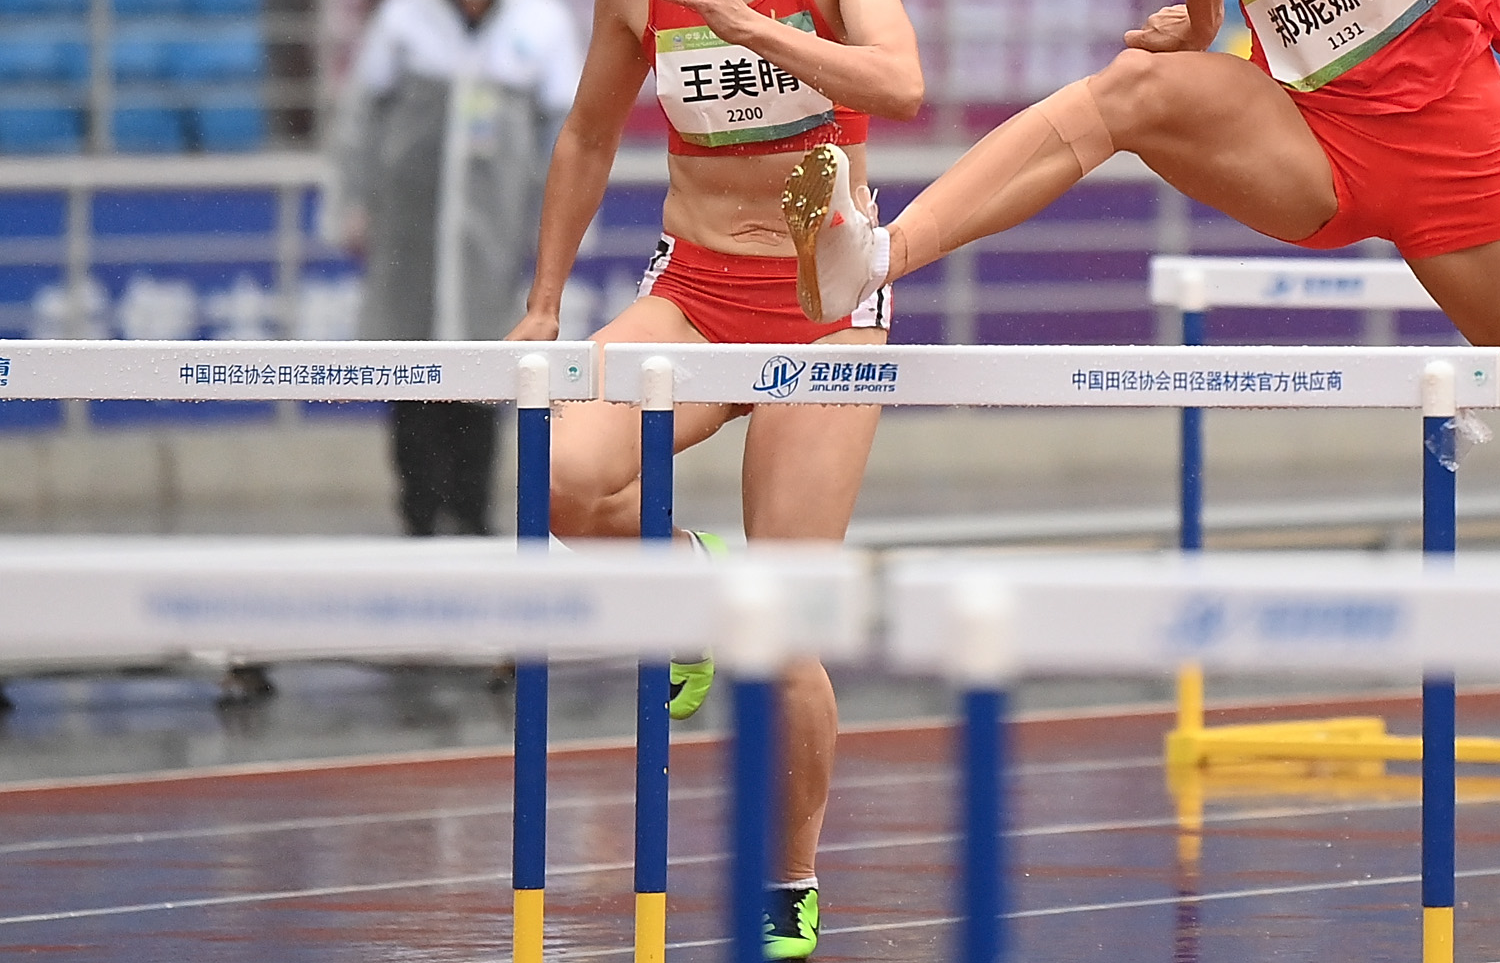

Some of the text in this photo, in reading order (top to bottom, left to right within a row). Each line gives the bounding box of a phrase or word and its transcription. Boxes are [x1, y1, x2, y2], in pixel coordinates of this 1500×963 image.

[1327, 21, 1365, 50] 1131
[680, 58, 800, 103] 王美晴
[726, 106, 763, 123] 2200
[179, 363, 442, 387] 中国田径协会田径器材类官方供应商
[809, 362, 899, 382] 金陵体育
[1071, 368, 1343, 393] 中国田径协会田径器材类官方供应商
[854, 383, 896, 393] SPORTS
